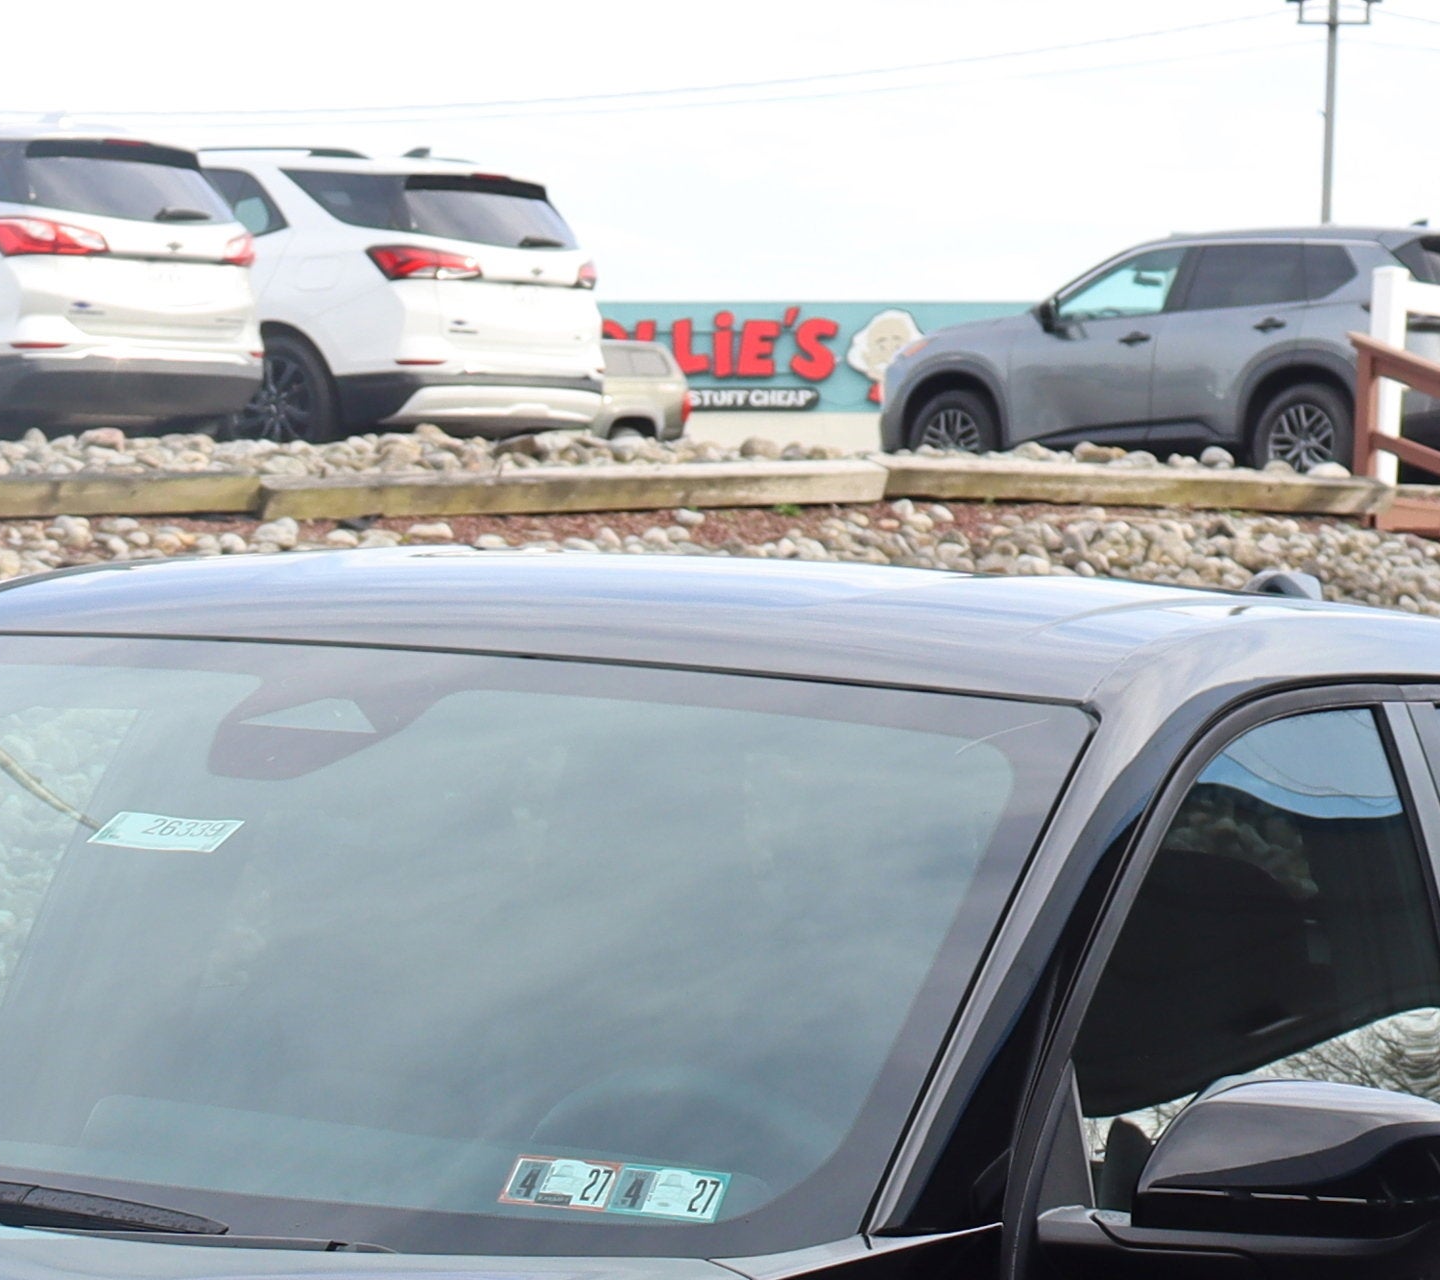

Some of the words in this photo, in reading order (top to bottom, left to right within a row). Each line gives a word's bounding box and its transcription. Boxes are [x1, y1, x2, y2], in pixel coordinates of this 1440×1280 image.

[749, 388, 813, 407] CHEAP
[141, 818, 226, 837] 26339
[519, 1168, 541, 1197] 4
[580, 1168, 614, 1203] 27
[623, 1178, 646, 1207] 4
[687, 1179, 720, 1215] 27
